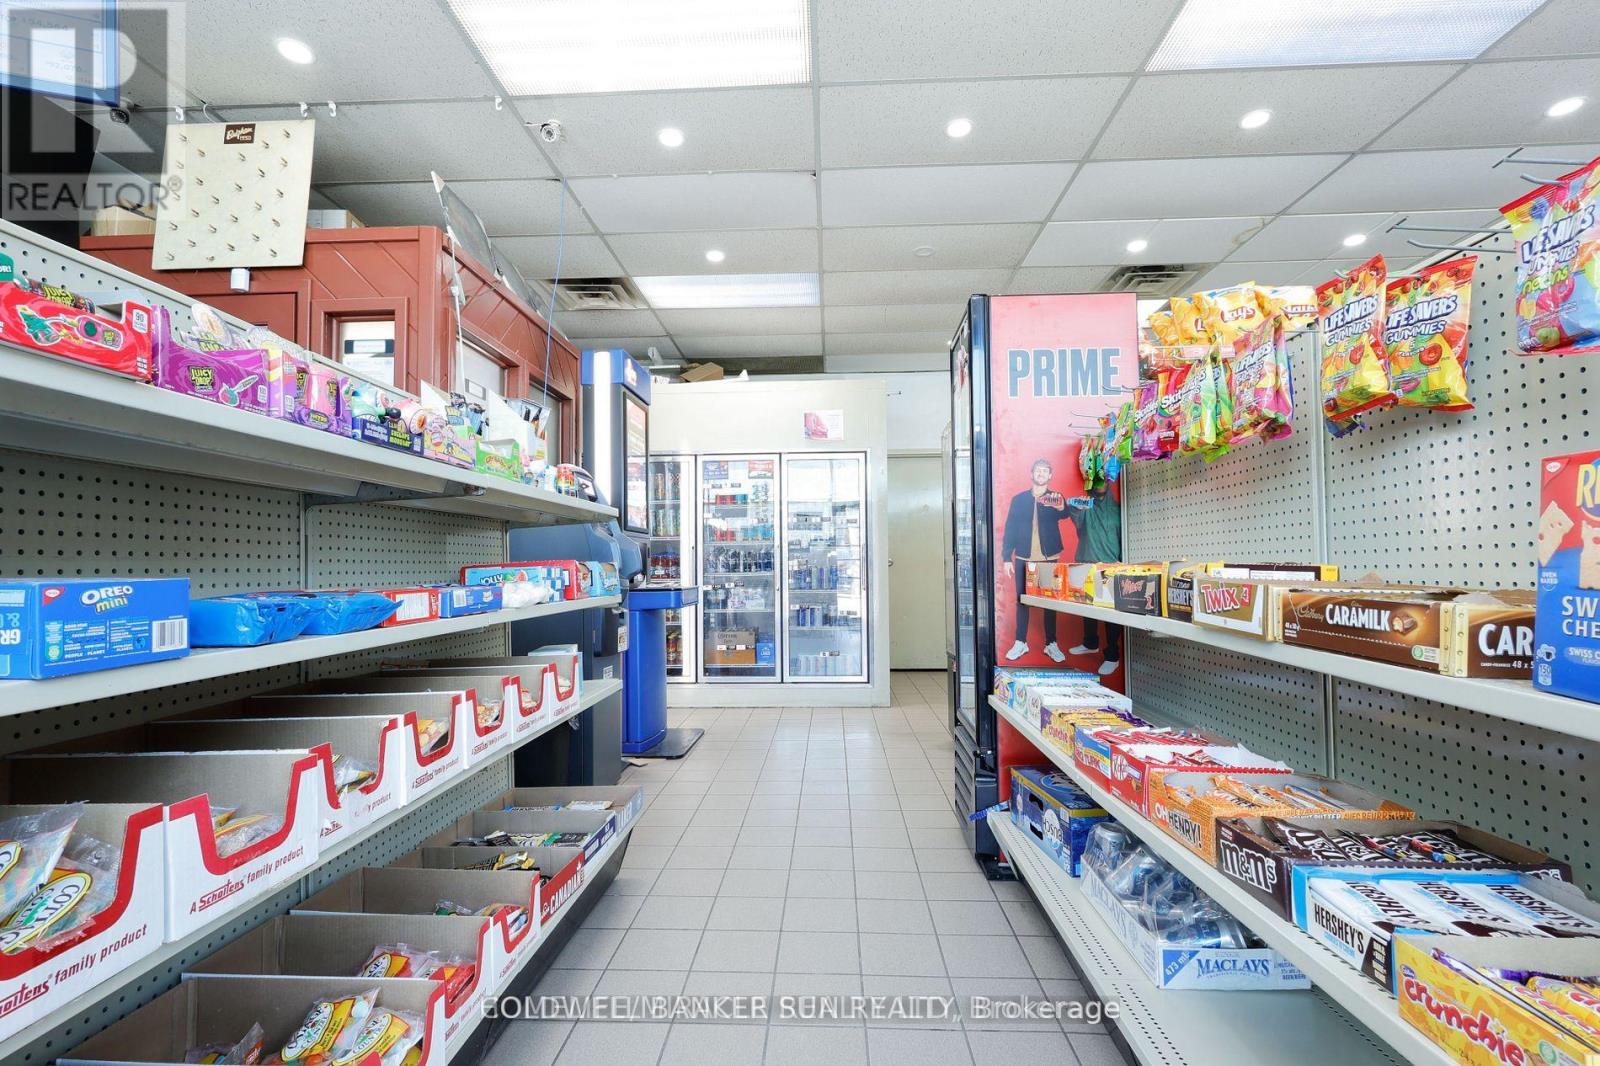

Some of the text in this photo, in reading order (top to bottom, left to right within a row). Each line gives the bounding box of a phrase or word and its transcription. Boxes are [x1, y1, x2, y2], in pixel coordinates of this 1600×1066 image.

[1408, 294, 1458, 324] SAVERS
[1385, 319, 1447, 346] GUMMIES
[1007, 347, 1122, 398] PRIME
[480, 574, 504, 584] JOLLY
[81, 585, 133, 605] OREO
[96, 596, 128, 613] mini
[1562, 595, 1599, 618] SW
[1325, 603, 1391, 632] CARAMILK
[1478, 623, 1534, 657] CAR
[1568, 646, 1593, 659] SWISS
[1512, 661, 1522, 669] 48
[1154, 802, 1203, 849] OH HENRY!
[189, 845, 305, 915] A Scholtens family product
[1314, 903, 1364, 955] HERSHEY'S
[54, 952, 96, 985] family
[100, 924, 148, 962] product
[1196, 958, 1270, 978] MACLAYS
[1165, 961, 1179, 977] 473
